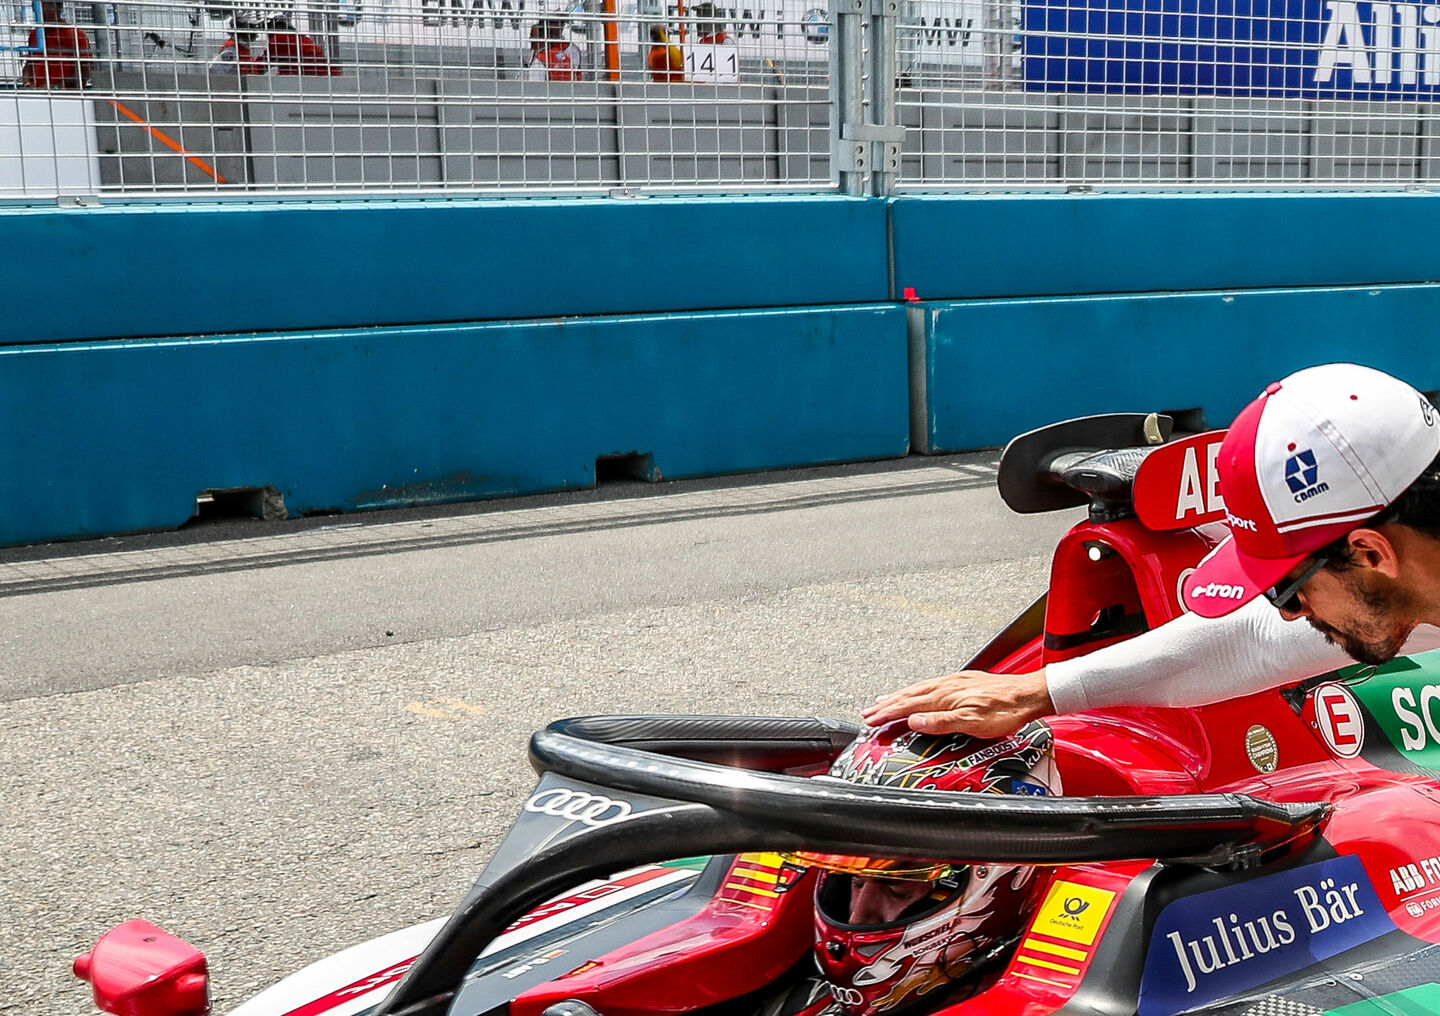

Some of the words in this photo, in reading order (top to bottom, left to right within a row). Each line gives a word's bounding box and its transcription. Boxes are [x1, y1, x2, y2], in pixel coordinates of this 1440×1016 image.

[1294, 481, 1330, 504] CBMM
[1227, 509, 1257, 533] port
[1191, 581, 1245, 600] e-tron
[1166, 907, 1296, 993] Julius
[1293, 877, 1366, 936] Bär
